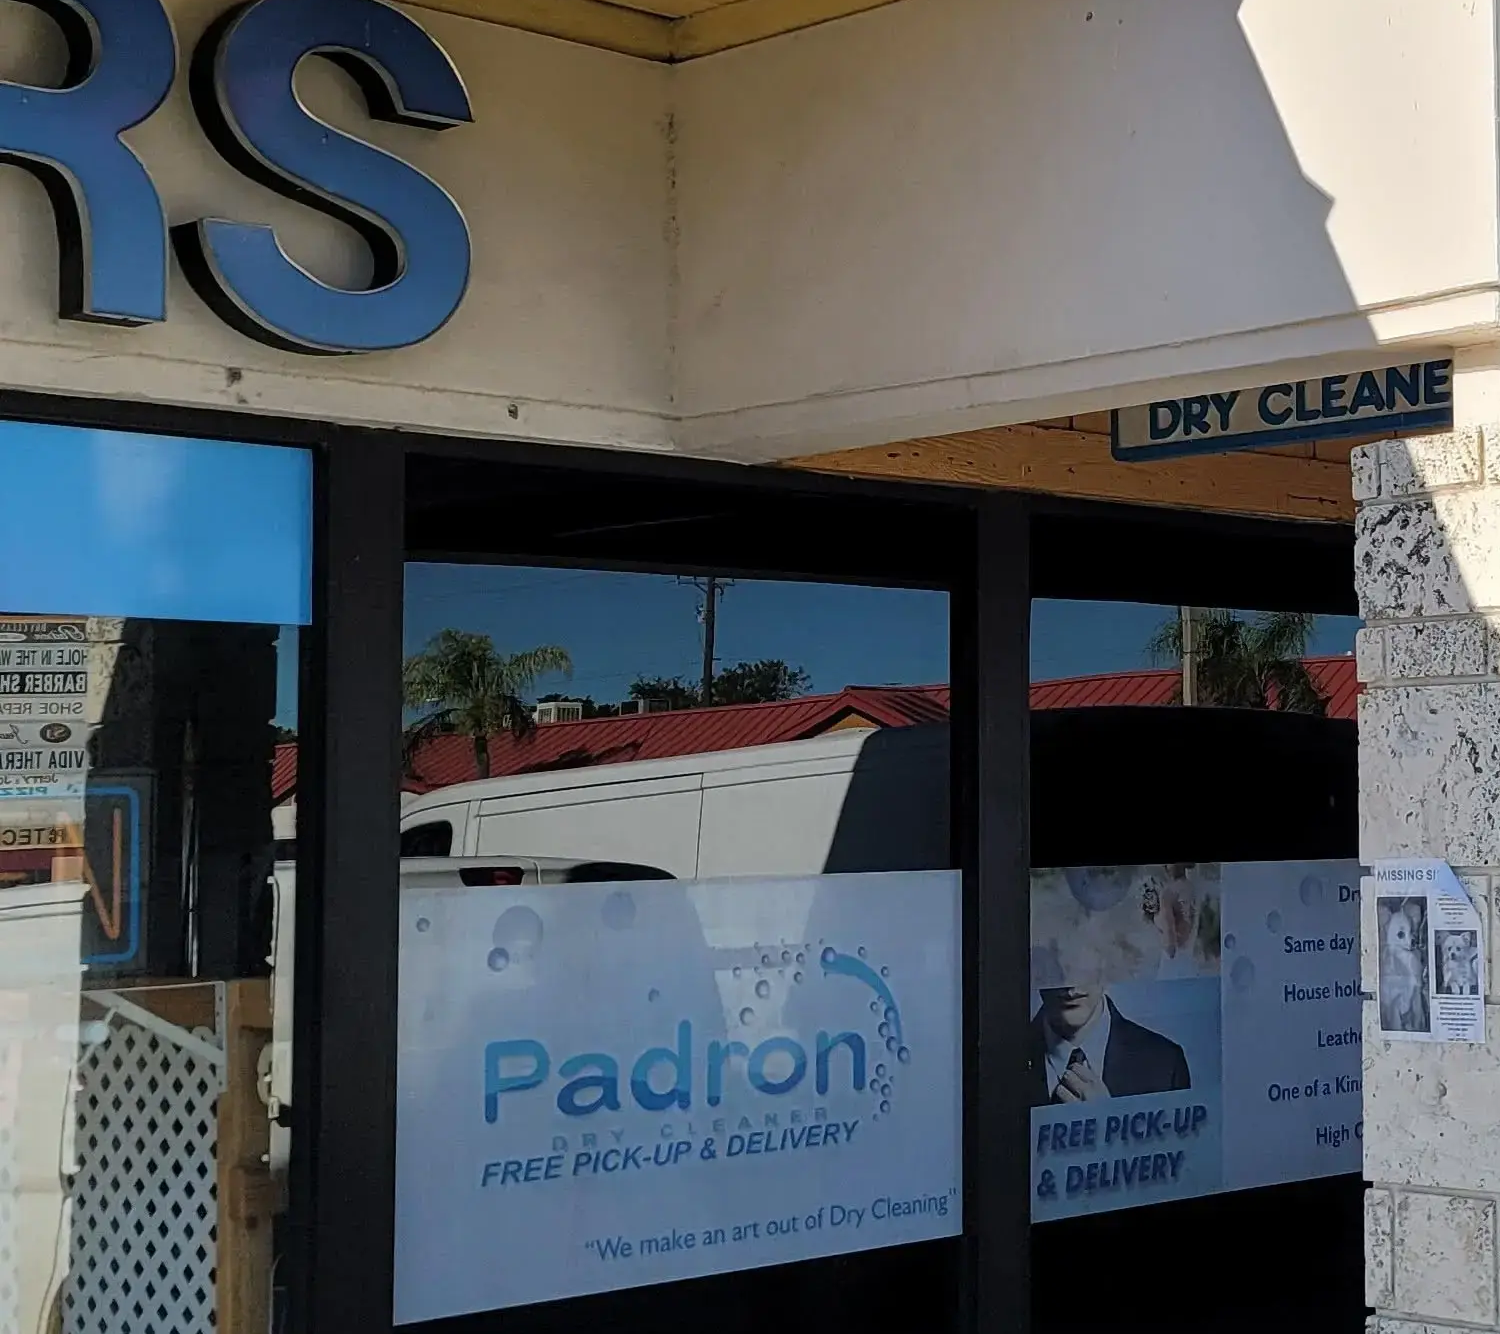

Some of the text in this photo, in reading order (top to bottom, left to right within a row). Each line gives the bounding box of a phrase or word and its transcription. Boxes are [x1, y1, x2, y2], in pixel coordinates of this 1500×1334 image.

[1147, 389, 1241, 441] DRY
[1376, 869, 1424, 882] MISSING
[1284, 934, 1354, 955] Same day
[1284, 982, 1331, 1003] House
[483, 1020, 867, 1125] Padron
[1268, 1075, 1363, 1103] One of a Kin
[552, 1128, 625, 1153] DRY
[1037, 1104, 1208, 1154] FREE PICK-UP
[1316, 1124, 1351, 1148] High
[480, 1120, 860, 1188] FREE PICK-UP & DELIVERY
[1036, 1150, 1186, 1198] & DELIVERY
[639, 1228, 697, 1257] make
[703, 1227, 727, 1247] an
[732, 1221, 760, 1243] art
[766, 1214, 799, 1238] out
[805, 1207, 825, 1231] of
[830, 1203, 866, 1230] Dry
